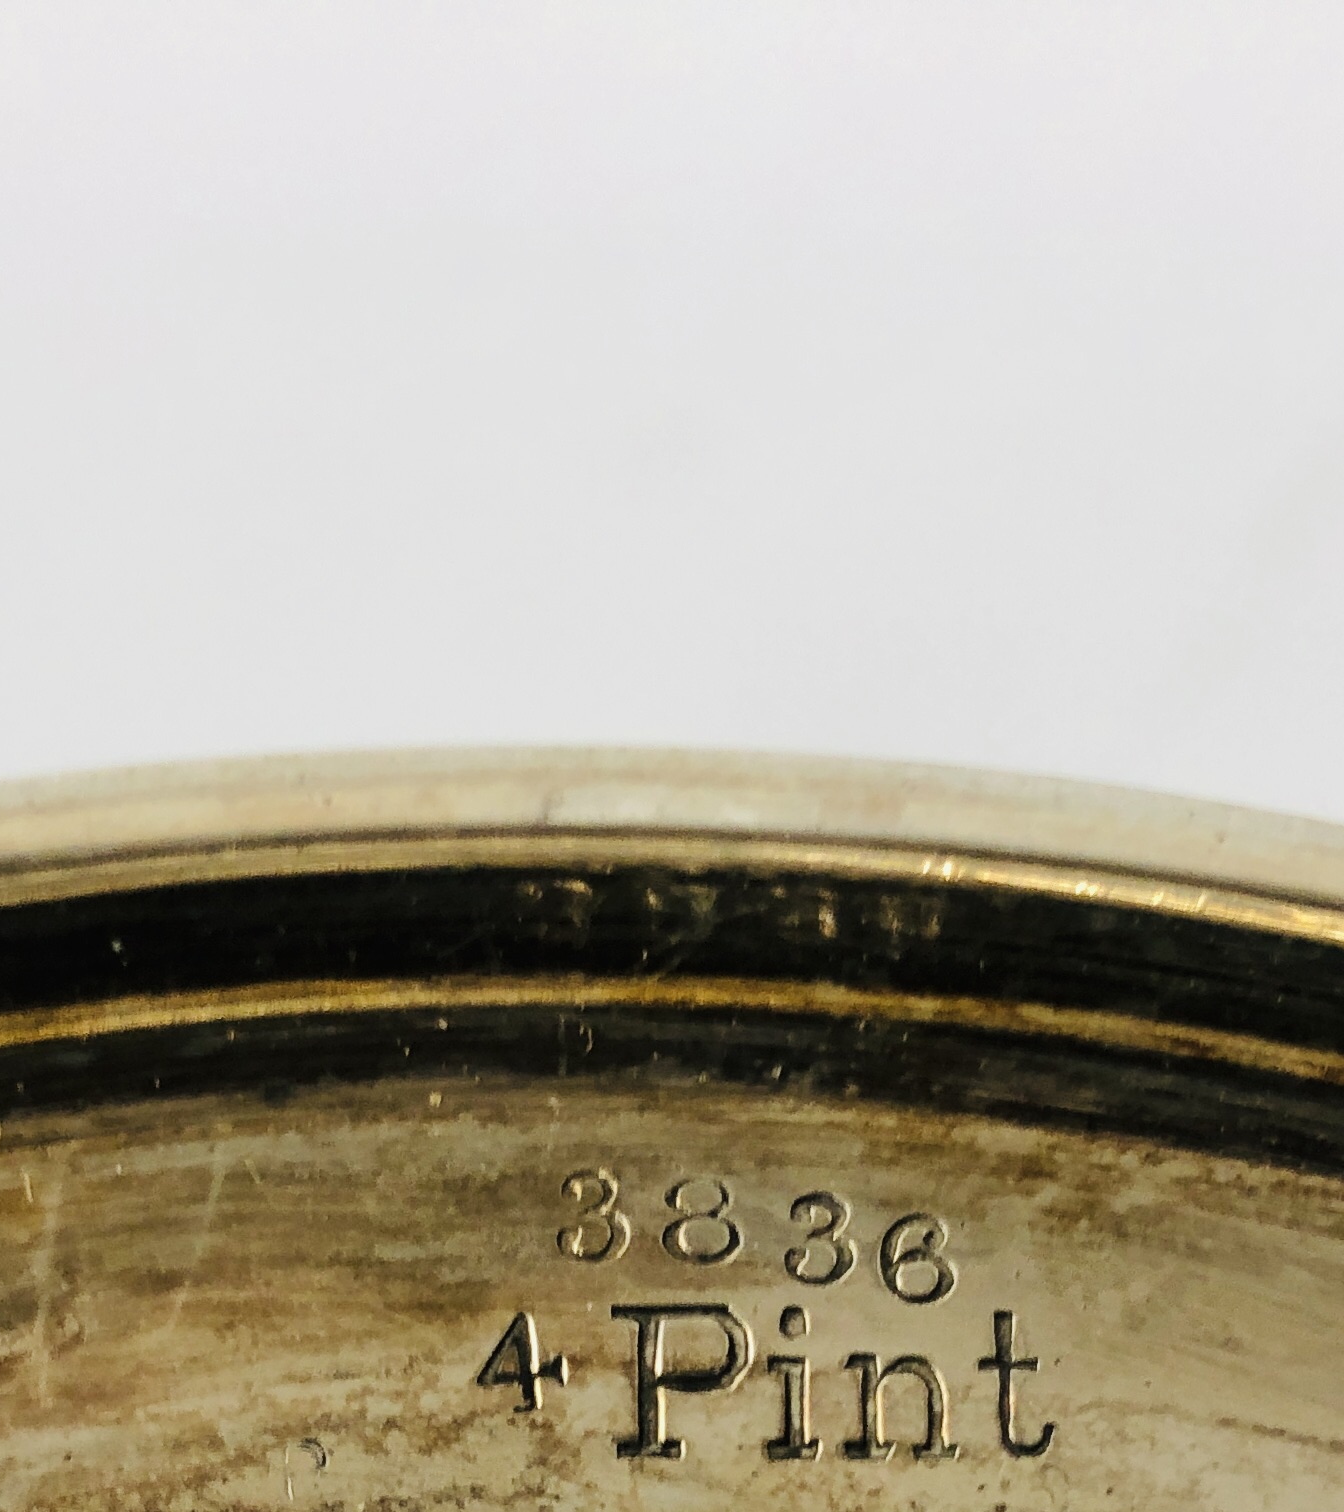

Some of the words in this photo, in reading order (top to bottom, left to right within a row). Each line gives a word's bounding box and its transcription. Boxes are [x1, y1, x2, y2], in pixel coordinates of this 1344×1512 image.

[556, 1166, 958, 1303] 3836
[476, 1310, 570, 1413] 4
[610, 1303, 1056, 1461] Pint
